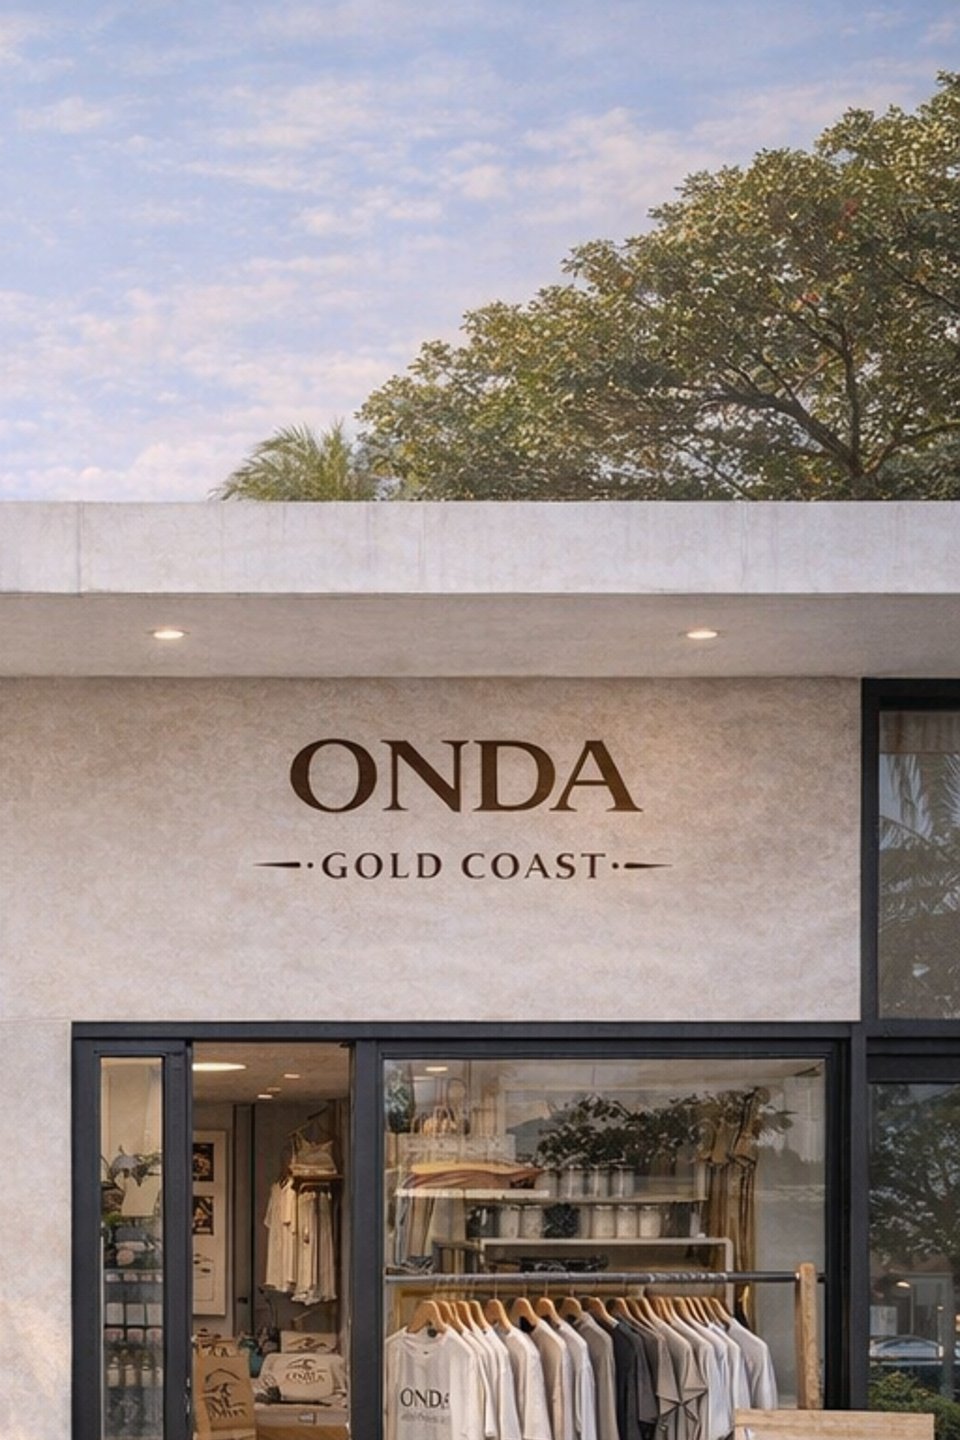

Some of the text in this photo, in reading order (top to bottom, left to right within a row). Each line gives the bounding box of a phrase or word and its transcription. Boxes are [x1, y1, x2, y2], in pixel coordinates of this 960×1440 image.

[290, 737, 643, 814] ONDA
[321, 852, 606, 880] GOLD COAST
